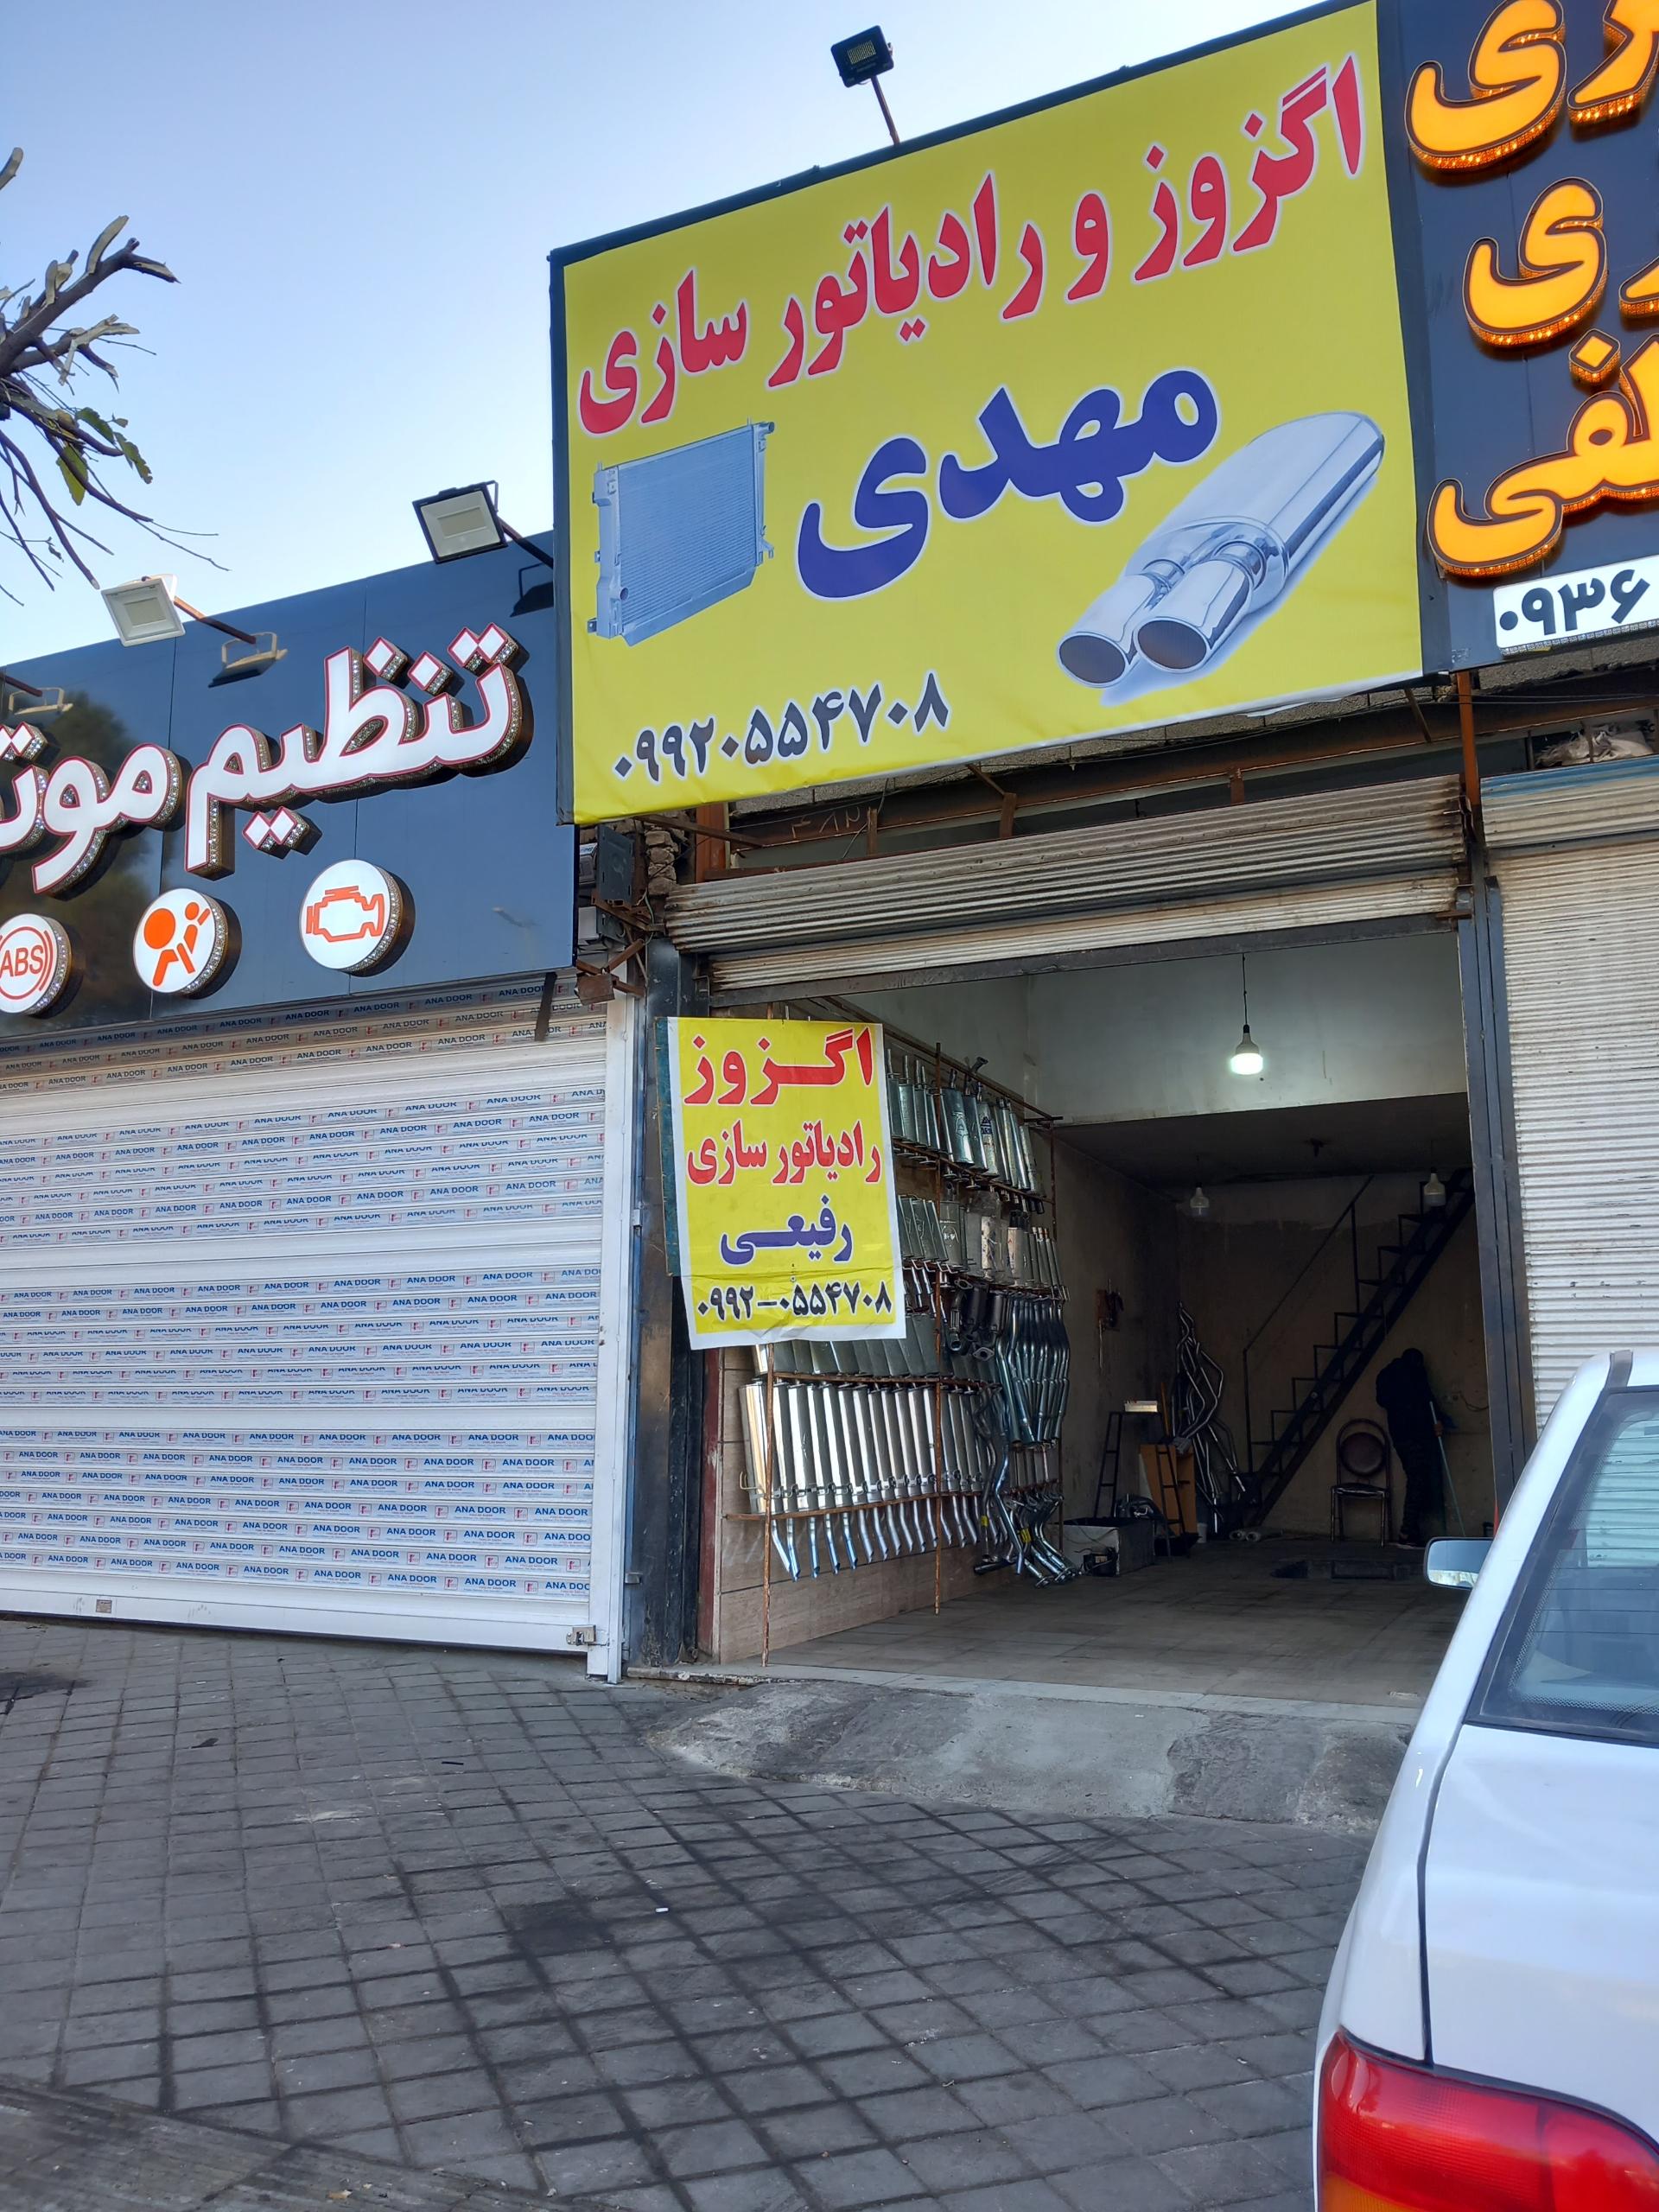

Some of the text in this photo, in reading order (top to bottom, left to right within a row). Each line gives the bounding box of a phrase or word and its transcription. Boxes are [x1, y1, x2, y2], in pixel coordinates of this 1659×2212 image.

[1134, 54, 1361, 283] اگزوز
[1067, 193, 1108, 301] و
[767, 173, 1043, 388] رادیاتور
[579, 270, 747, 434] سازی
[798, 370, 1218, 599] مهدی
[1498, 568, 1651, 636] ۰۹۳۶
[184, 622, 518, 874] تنظیم
[613, 671, 951, 782] ۰۹۹۲۰۵۵۴۷۰۸
[0, 944, 44, 977] ABS
[238, 1017, 262, 1026] DOOR
[284, 1012, 303, 1021] ANA
[304, 1009, 330, 1018] DOOR
[352, 1005, 372, 1013] ANA
[373, 1002, 400, 1011] DOOR
[424, 997, 444, 1005] ANA
[445, 993, 473, 1003] DOOR
[264, 1034, 289, 1042] DOOR
[332, 1026, 358, 1035] DOOR
[381, 1021, 402, 1030] ANA
[403, 1018, 429, 1027] DOOR
[454, 1014, 475, 1022] ANA
[476, 1011, 503, 1019] DOOR
[249, 1056, 273, 1064] DOOR
[316, 1049, 342, 1057] DOOR
[386, 1041, 412, 1050] DOOR
[437, 1037, 457, 1045] ANA
[458, 1034, 486, 1043] DOOR
[683, 1027, 874, 1106] اگزوز
[260, 1136, 285, 1144] DOOR
[400, 1124, 427, 1133] DOOR
[474, 1118, 502, 1126] DOOR
[550, 1112, 579, 1121] DOOR
[687, 1121, 881, 1185] رادیاتور سازی
[238, 1200, 262, 1208] DOOR
[306, 1195, 332, 1203] DOOR
[377, 1190, 404, 1199] DOOR
[451, 1185, 479, 1194] DOOR
[527, 1180, 556, 1189] DOOR
[721, 1195, 854, 1265] رفیعی
[386, 1527, 407, 1535] ANA
[408, 1528, 436, 1536] DOOR
[463, 1530, 485, 1538] ANA
[486, 1531, 515, 1539] DOOR
[477, 1506, 506, 1514] DOOR
[534, 1507, 556, 1515] ANA
[558, 1508, 588, 1516] DOOR
[263, 1566, 289, 1575] DOOR
[334, 1571, 361, 1579] DOOR
[387, 1573, 407, 1582] ANA
[409, 1574, 437, 1583] DOOR
[464, 1577, 486, 1586] ANA
[487, 1579, 516, 1587] DOOR
[371, 1550, 399, 1558] DOOR
[448, 1553, 477, 1562] DOOR
[505, 1555, 526, 1564] ANA
[528, 1556, 558, 1565] DOOR
